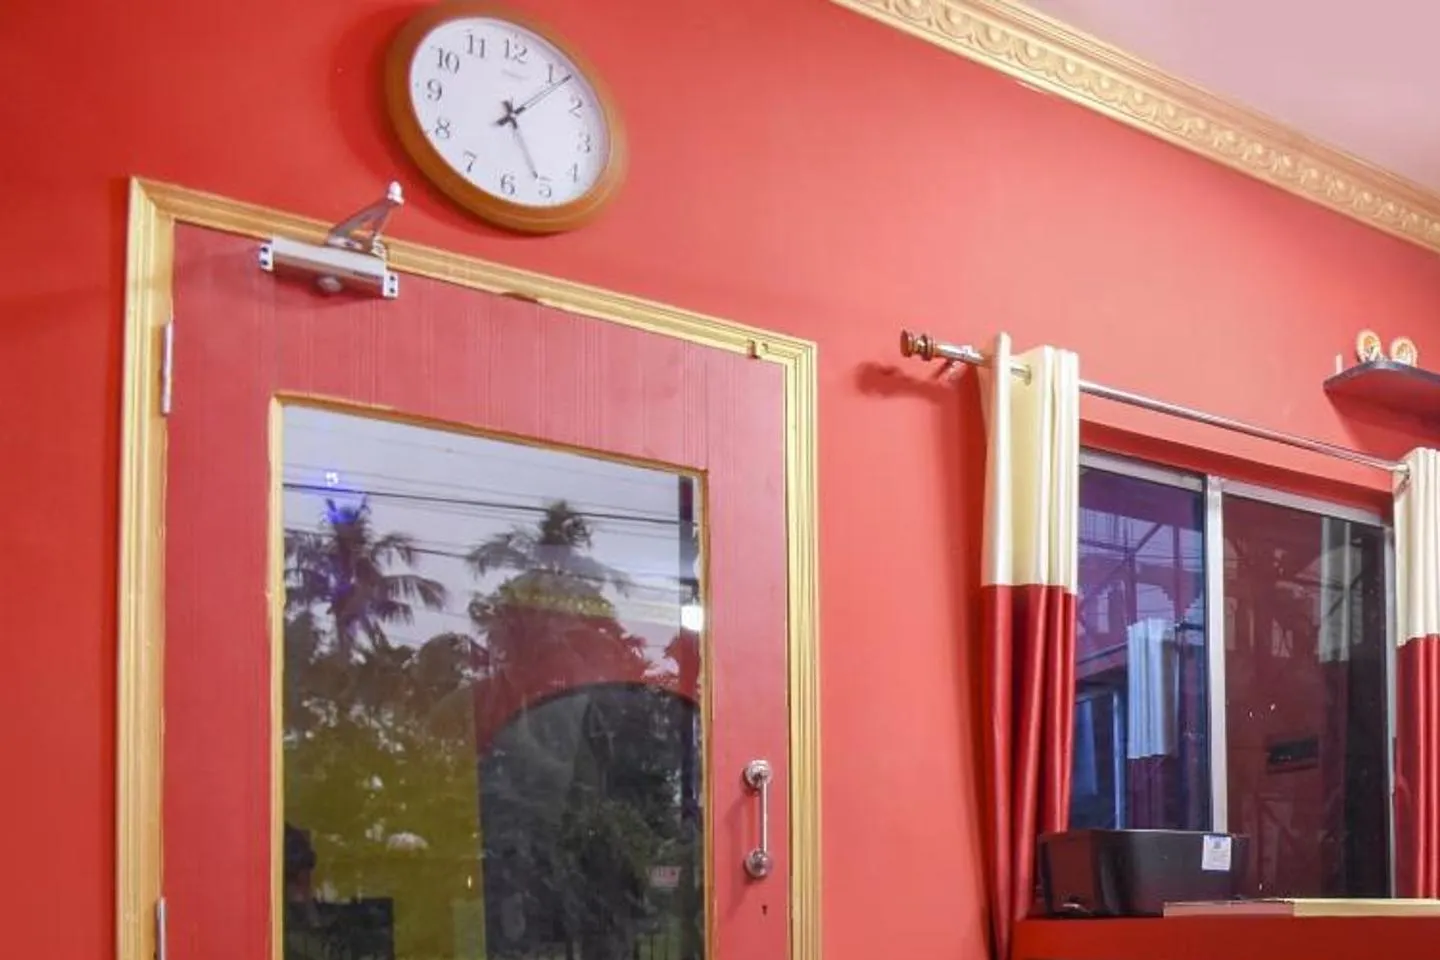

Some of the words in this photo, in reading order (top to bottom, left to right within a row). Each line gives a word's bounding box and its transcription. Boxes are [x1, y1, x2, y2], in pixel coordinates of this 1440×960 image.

[465, 34, 486, 58] 11
[504, 38, 528, 65] 12
[437, 48, 461, 73] 10
[426, 79, 443, 101] 9
[568, 96, 584, 118] 2
[434, 117, 451, 139] 8
[577, 130, 591, 154] 3
[464, 151, 478, 173] 7
[500, 173, 516, 196] 6
[538, 175, 554, 198] 5
